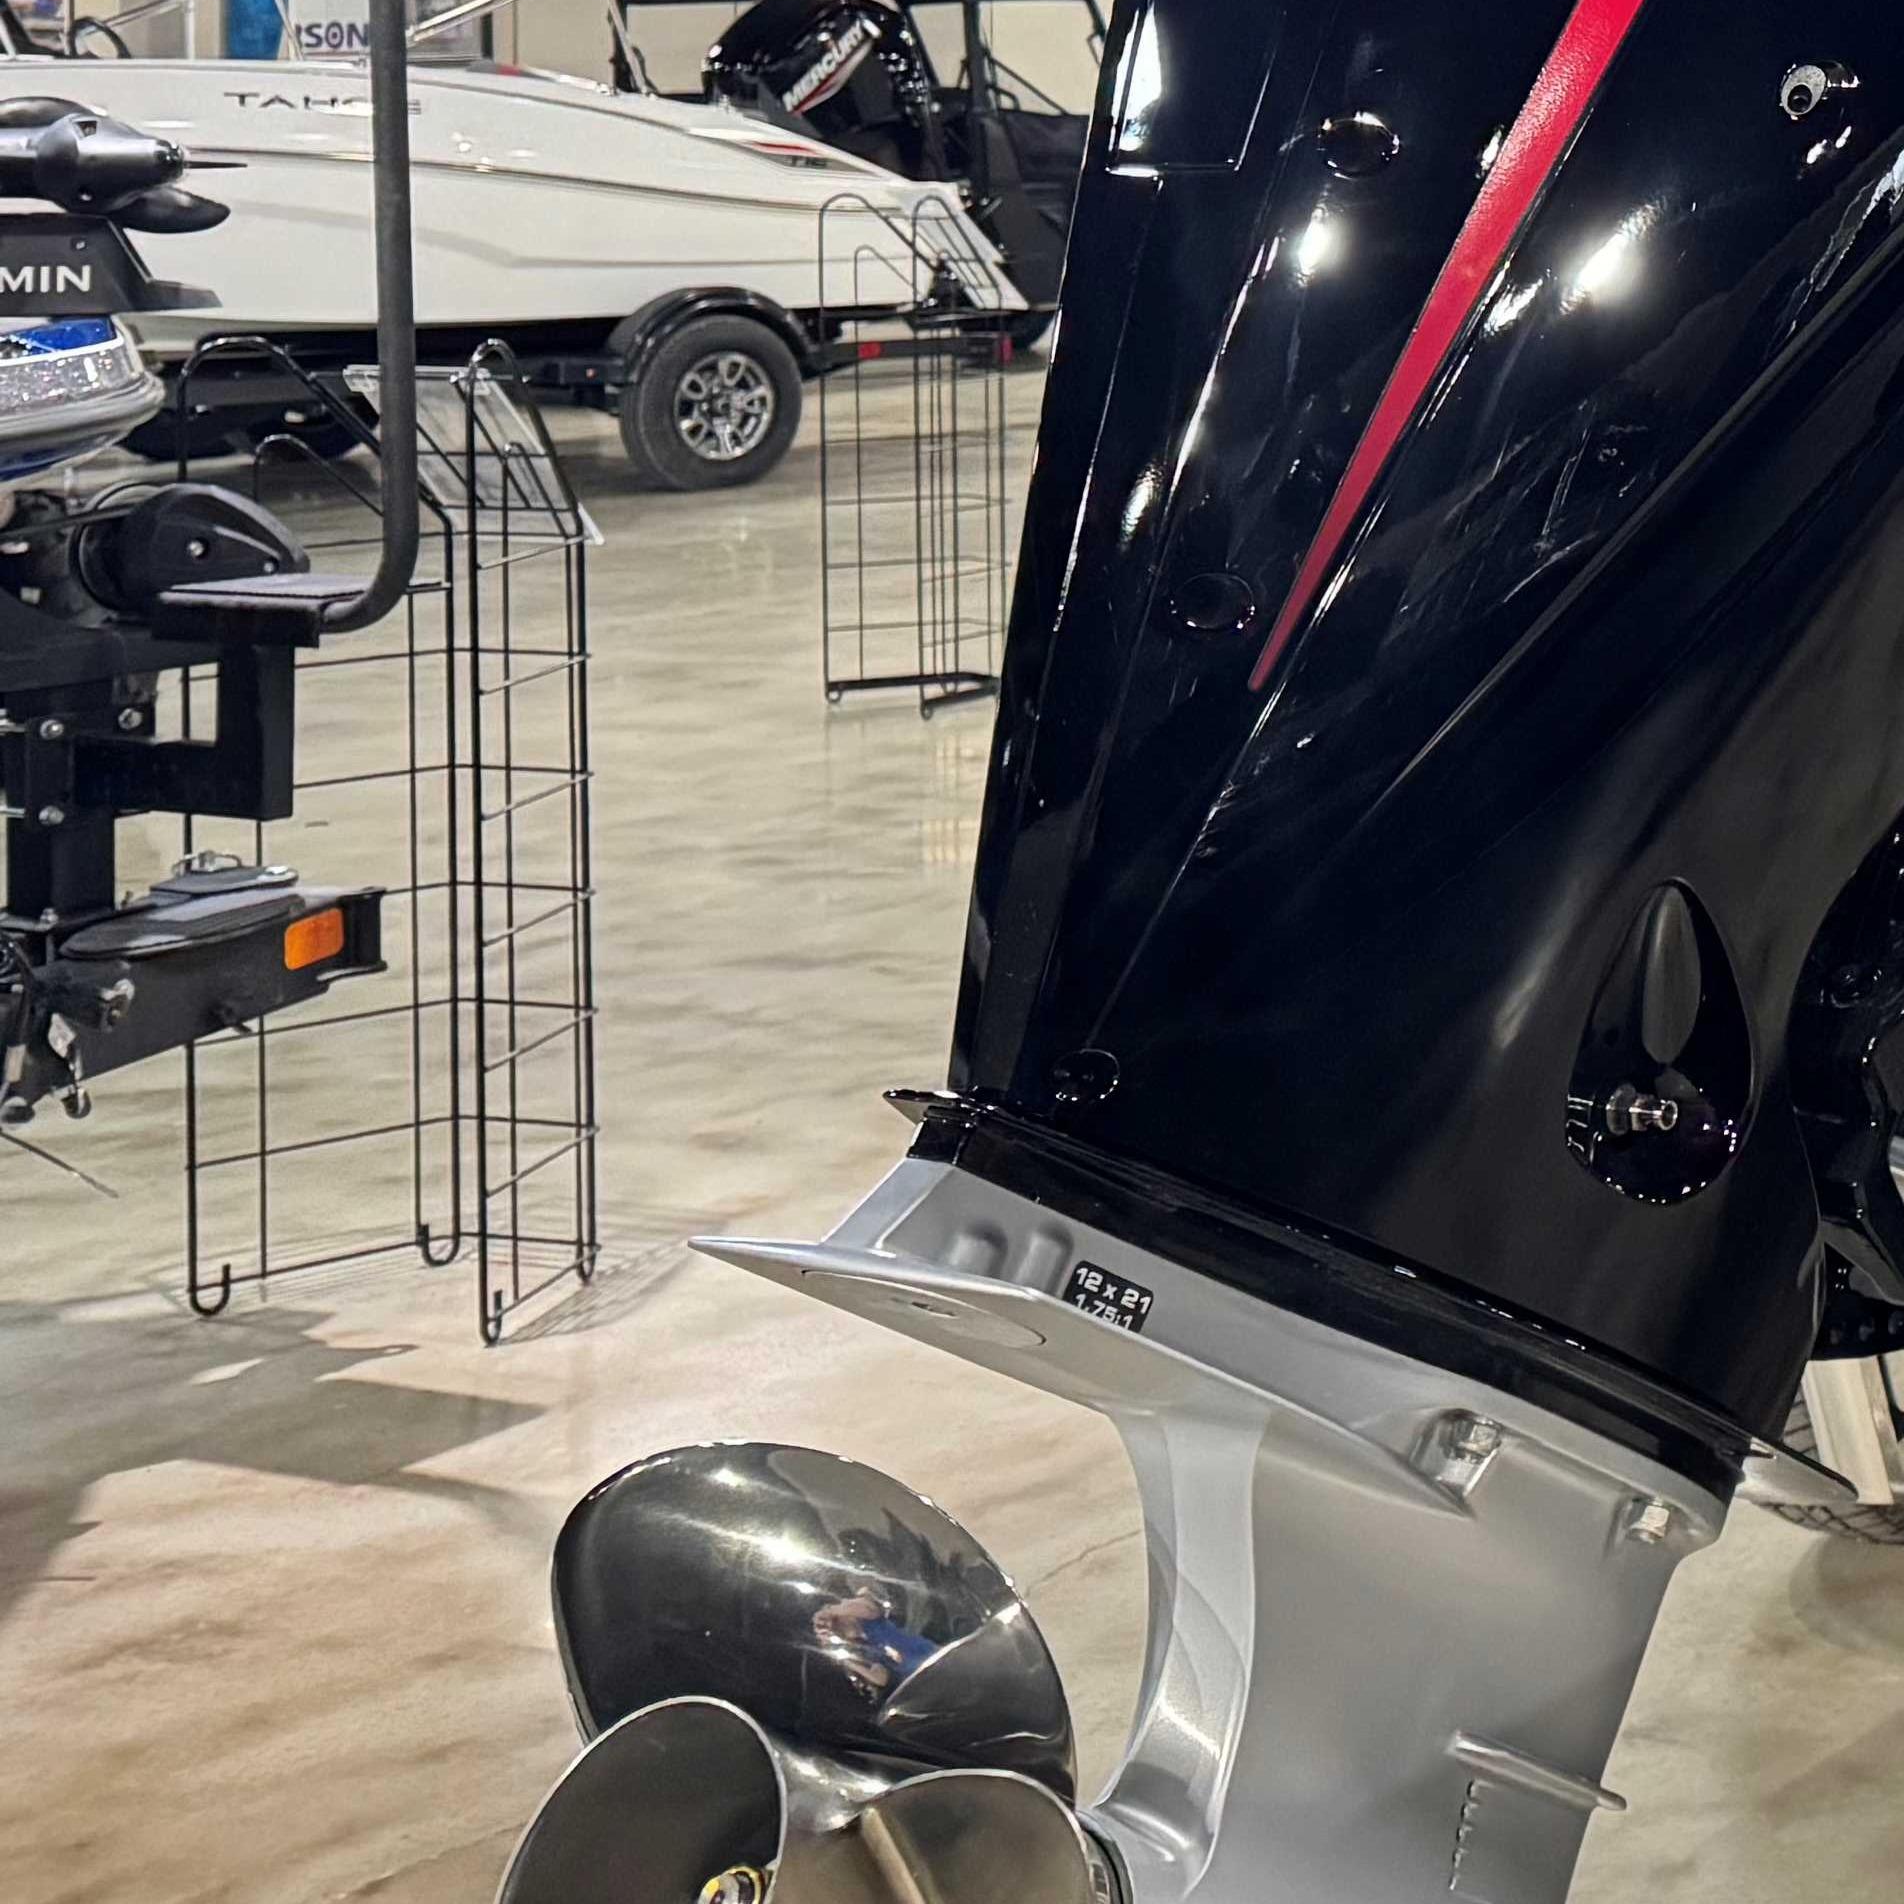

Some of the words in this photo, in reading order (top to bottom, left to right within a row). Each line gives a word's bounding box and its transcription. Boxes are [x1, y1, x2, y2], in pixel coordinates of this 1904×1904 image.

[296, 21, 368, 50] SON
[782, 18, 865, 113] MERCURY
[224, 92, 422, 116] TAHE
[1076, 1267, 1104, 1293] 12
[1102, 1283, 1118, 1300] x
[1120, 1288, 1152, 1314] 21
